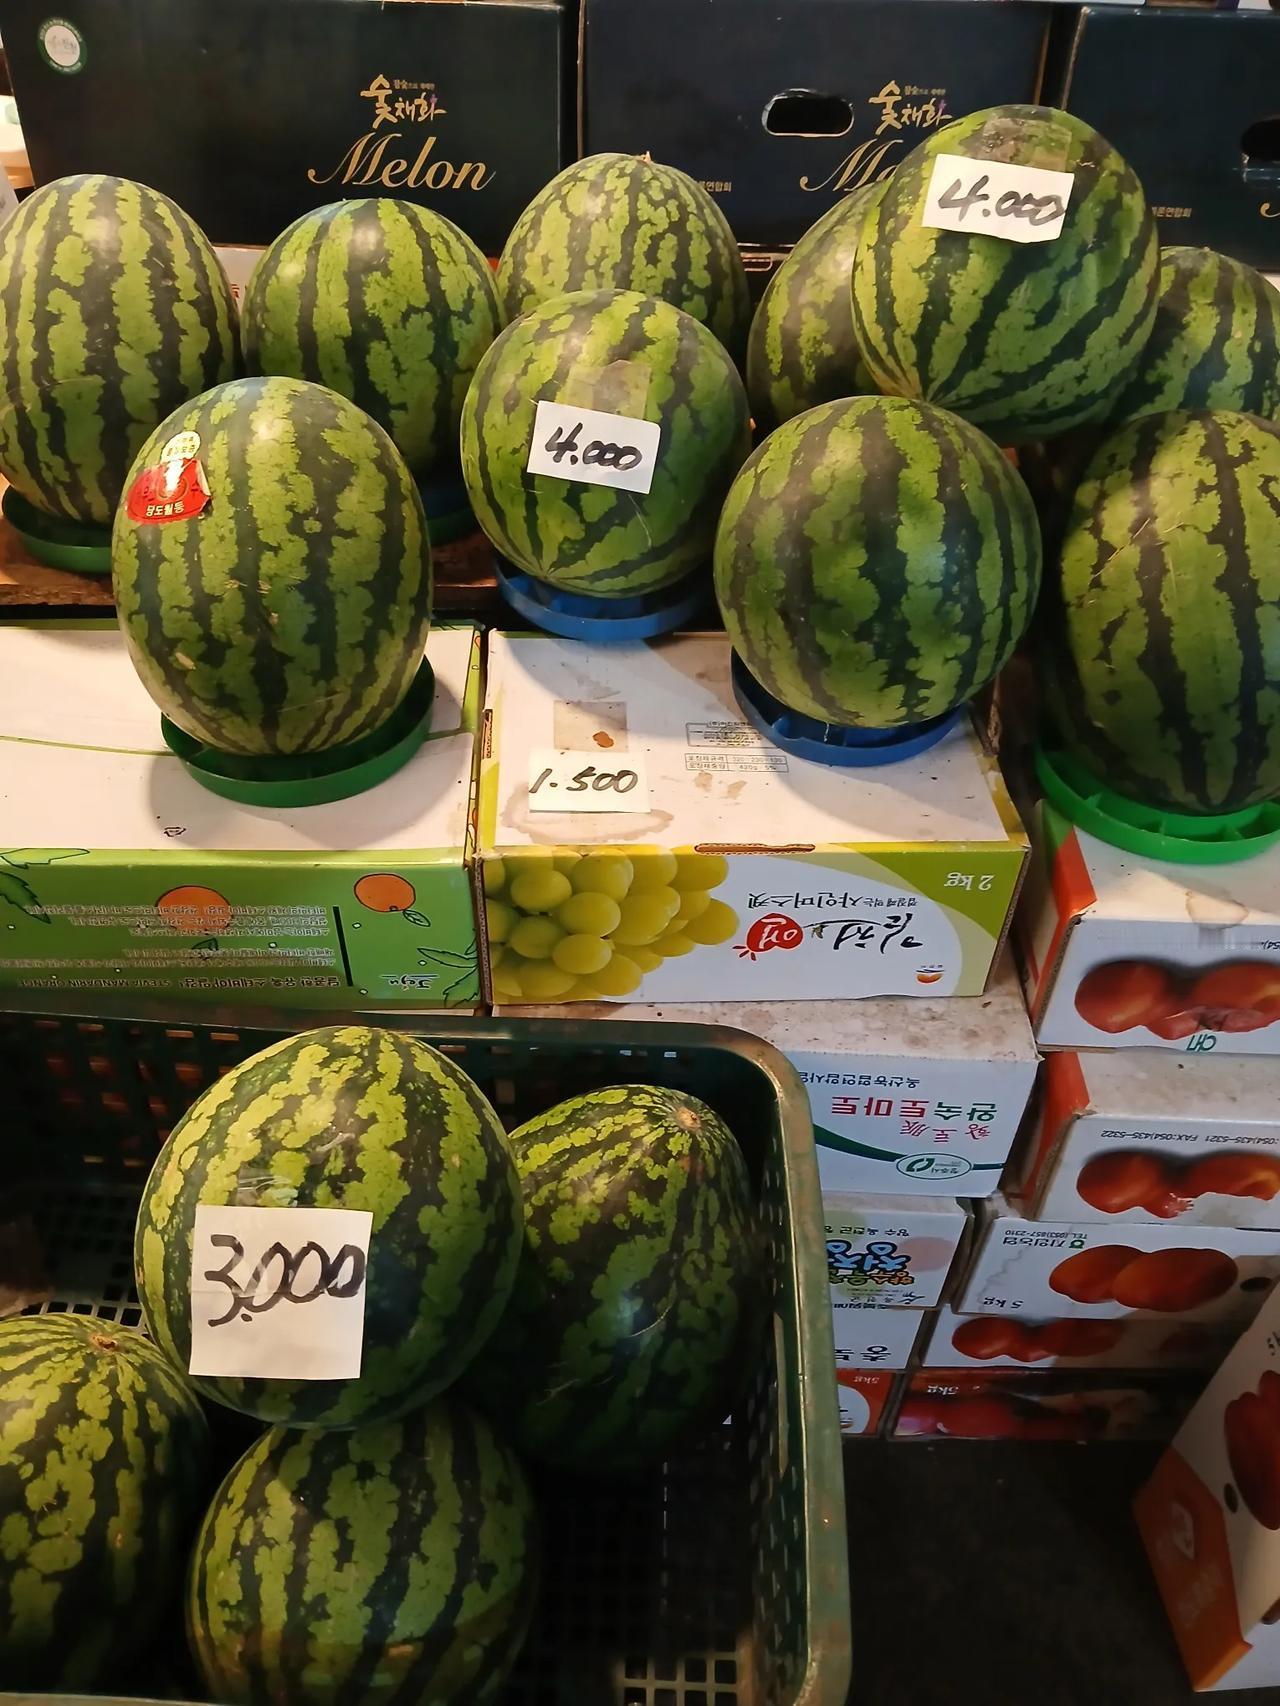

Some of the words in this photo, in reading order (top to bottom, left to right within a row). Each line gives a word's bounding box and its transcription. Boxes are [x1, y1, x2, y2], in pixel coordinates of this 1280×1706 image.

[307, 132, 497, 190] Melon
[938, 175, 1067, 226] 4.000
[545, 422, 642, 471] 4.000
[944, 872, 975, 891] kg
[978, 874, 995, 891] 2
[747, 892, 865, 909] 샤인머스켓
[863, 897, 884, 908] 먹는
[835, 913, 924, 955] 김천
[214, 977, 266, 988] 스테비아
[301, 976, 339, 988] 달콤한
[390, 975, 431, 991] Jeju
[831, 1097, 997, 1122] 완숙토마토
[983, 1297, 1006, 1308] kg
[1010, 1298, 1023, 1310] 5
[927, 1385, 959, 1396] 5kg
